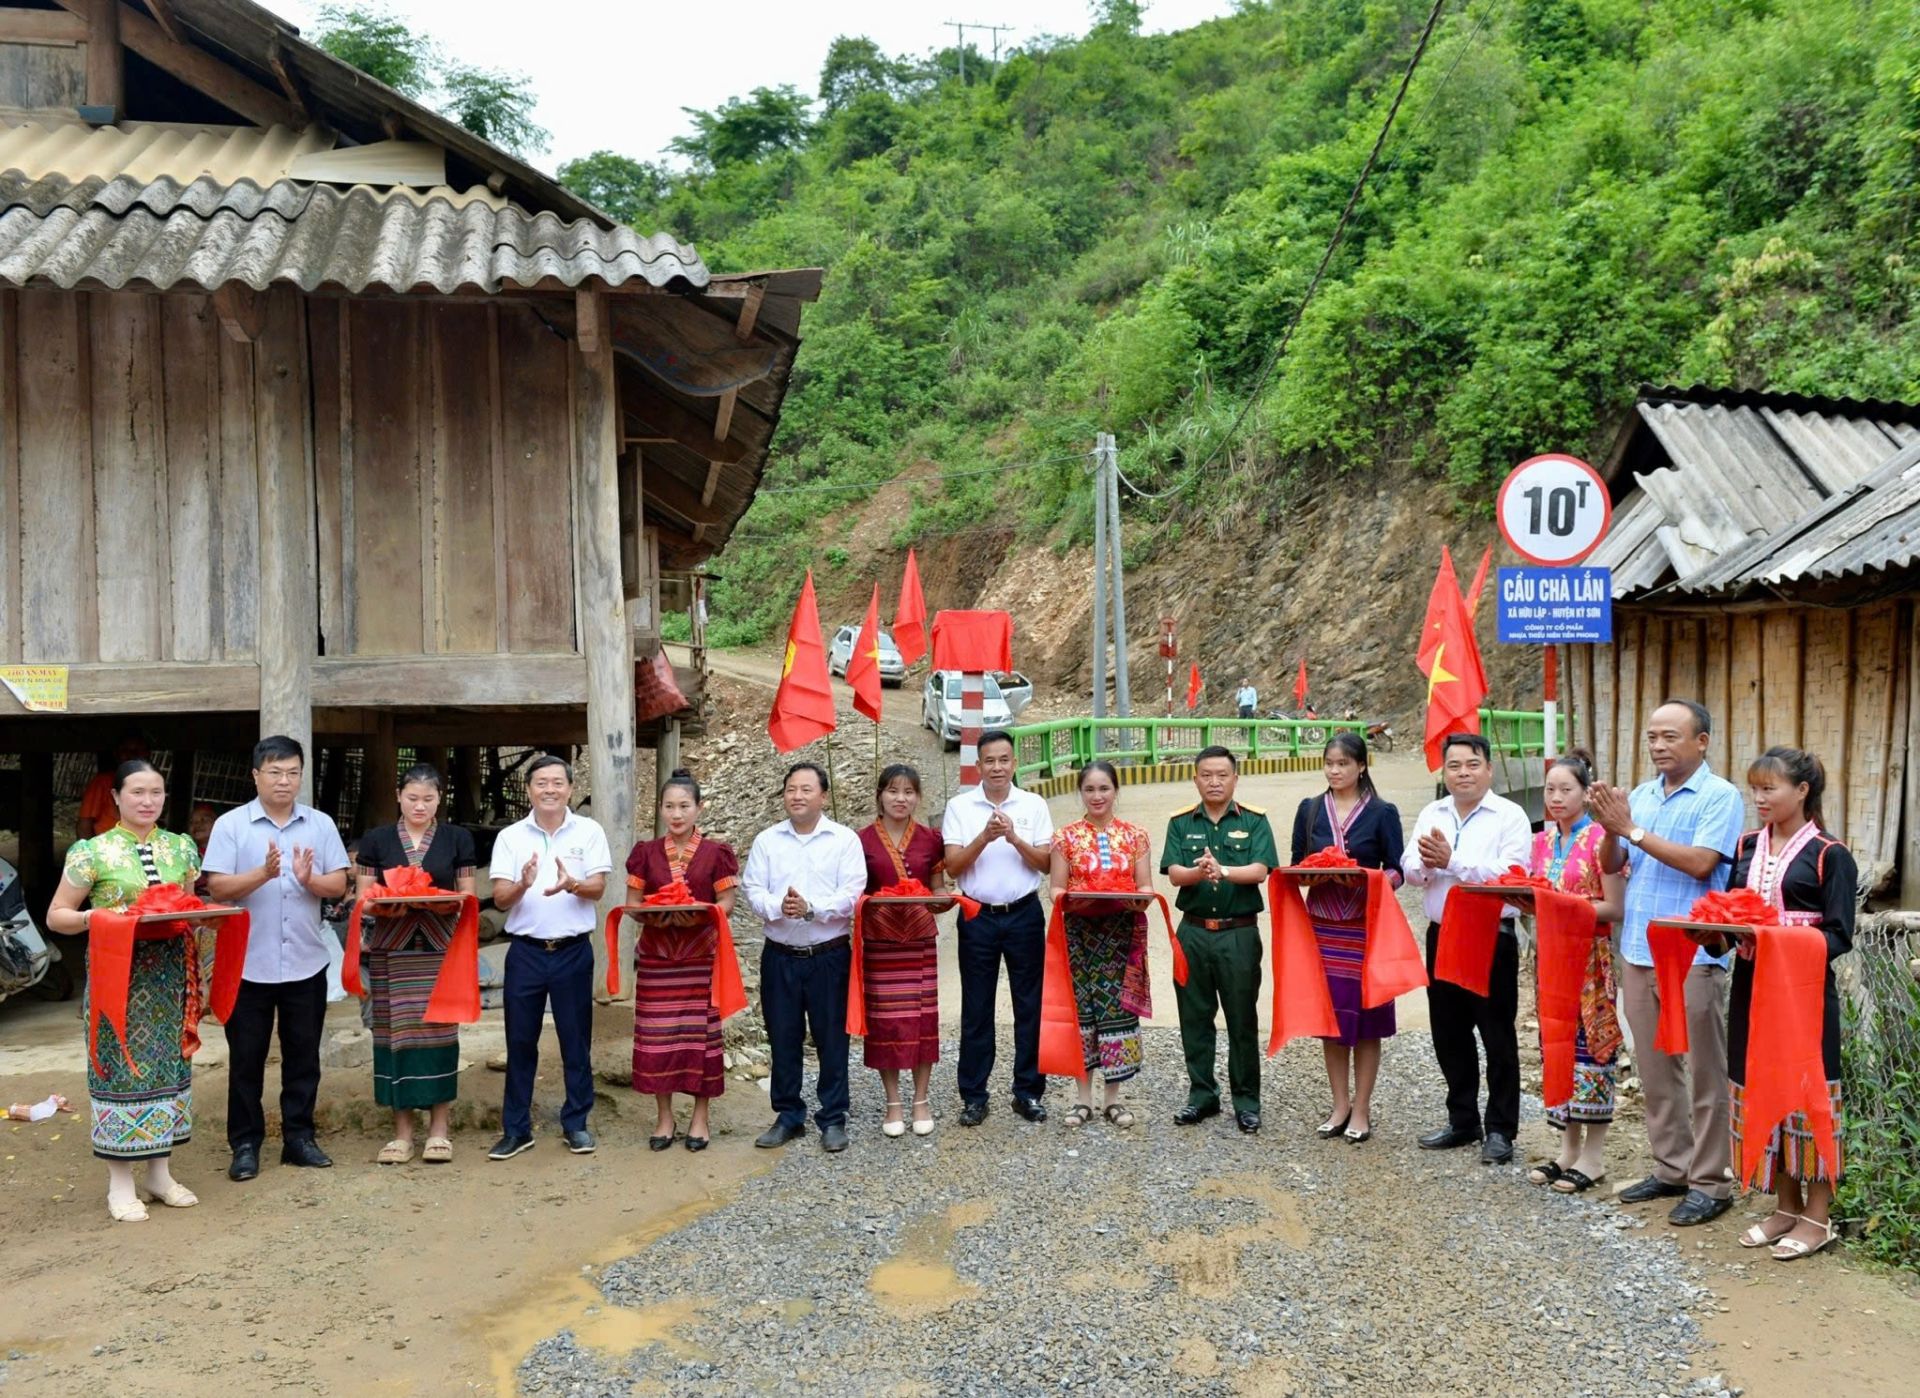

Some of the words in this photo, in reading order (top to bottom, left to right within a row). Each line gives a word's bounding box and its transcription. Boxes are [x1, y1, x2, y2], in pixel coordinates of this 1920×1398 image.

[1504, 570, 1535, 602] CẦU
[1539, 574, 1570, 602] CHÀ
[1574, 570, 1604, 602] LẮN
